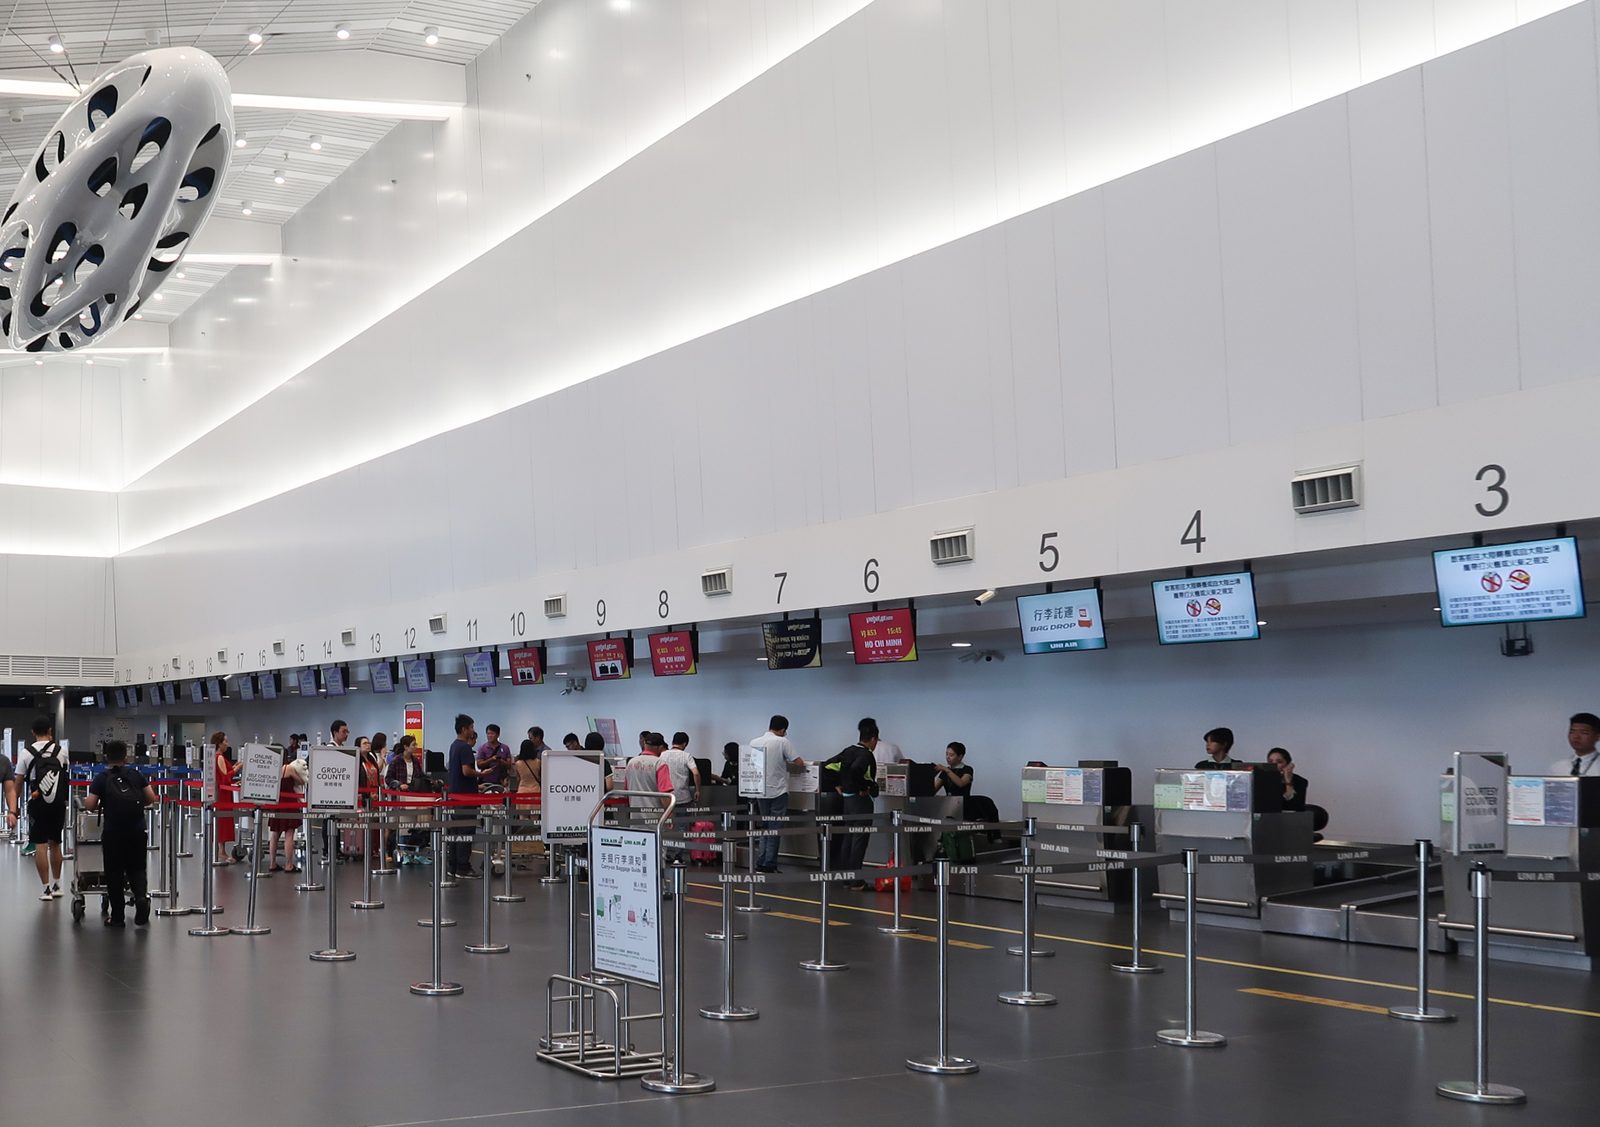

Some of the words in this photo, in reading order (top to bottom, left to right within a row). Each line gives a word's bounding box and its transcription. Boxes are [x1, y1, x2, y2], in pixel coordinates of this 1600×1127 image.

[1475, 464, 1509, 517] 3
[1180, 509, 1206, 553] 4
[1039, 532, 1059, 572] 5
[864, 558, 879, 593] 6
[774, 572, 787, 604] 7
[658, 590, 669, 618] 8
[597, 599, 606, 626] 9
[1034, 606, 1074, 621] 行李託運
[467, 618, 479, 642] 11
[510, 611, 525, 636] 10
[1050, 622, 1076, 631] DROP
[370, 633, 381, 653] 13
[404, 627, 416, 649] 12
[886, 638, 902, 647] MINH
[297, 643, 305, 662] 15
[323, 639, 332, 658] 14
[206, 657, 212, 673] 18
[237, 652, 244, 669] 17
[259, 649, 266, 667] 16
[163, 664, 169, 678] 20
[188, 660, 195, 675] 19
[39, 770, 55, 795] NIKE
[549, 784, 596, 793] ECONOMY
[1465, 787, 1498, 796] COURTESY
[1465, 796, 1498, 806] COUNTER
[1041, 843, 1055, 851] UNI
[1055, 845, 1069, 853] AIR
[1096, 850, 1111, 858] UNI
[1112, 851, 1127, 859] AIR
[1337, 852, 1353, 860] UNI
[958, 866, 978, 874] AIR
[1088, 863, 1106, 871] UNI
[719, 874, 741, 882] UNI
[745, 875, 765, 883] AIR
[810, 873, 832, 881] UNI
[834, 872, 855, 880] AIR
[1517, 872, 1536, 880] UNI
[1537, 872, 1554, 880] AIR
